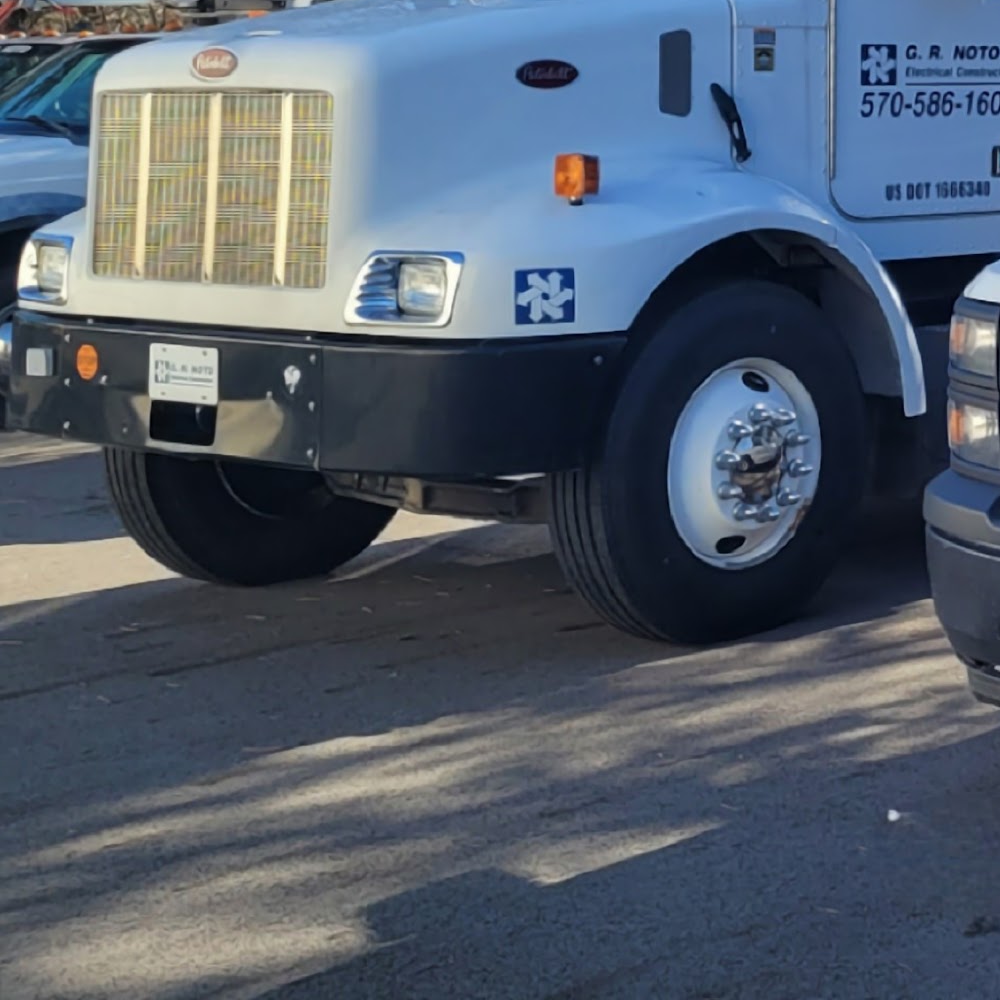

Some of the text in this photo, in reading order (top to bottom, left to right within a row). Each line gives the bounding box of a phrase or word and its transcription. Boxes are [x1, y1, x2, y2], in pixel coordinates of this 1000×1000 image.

[905, 45, 922, 60] G.
[953, 46, 1000, 60] NOTO
[905, 67, 953, 77] Electrical
[885, 184, 902, 201] US
[906, 182, 931, 200] DOT
